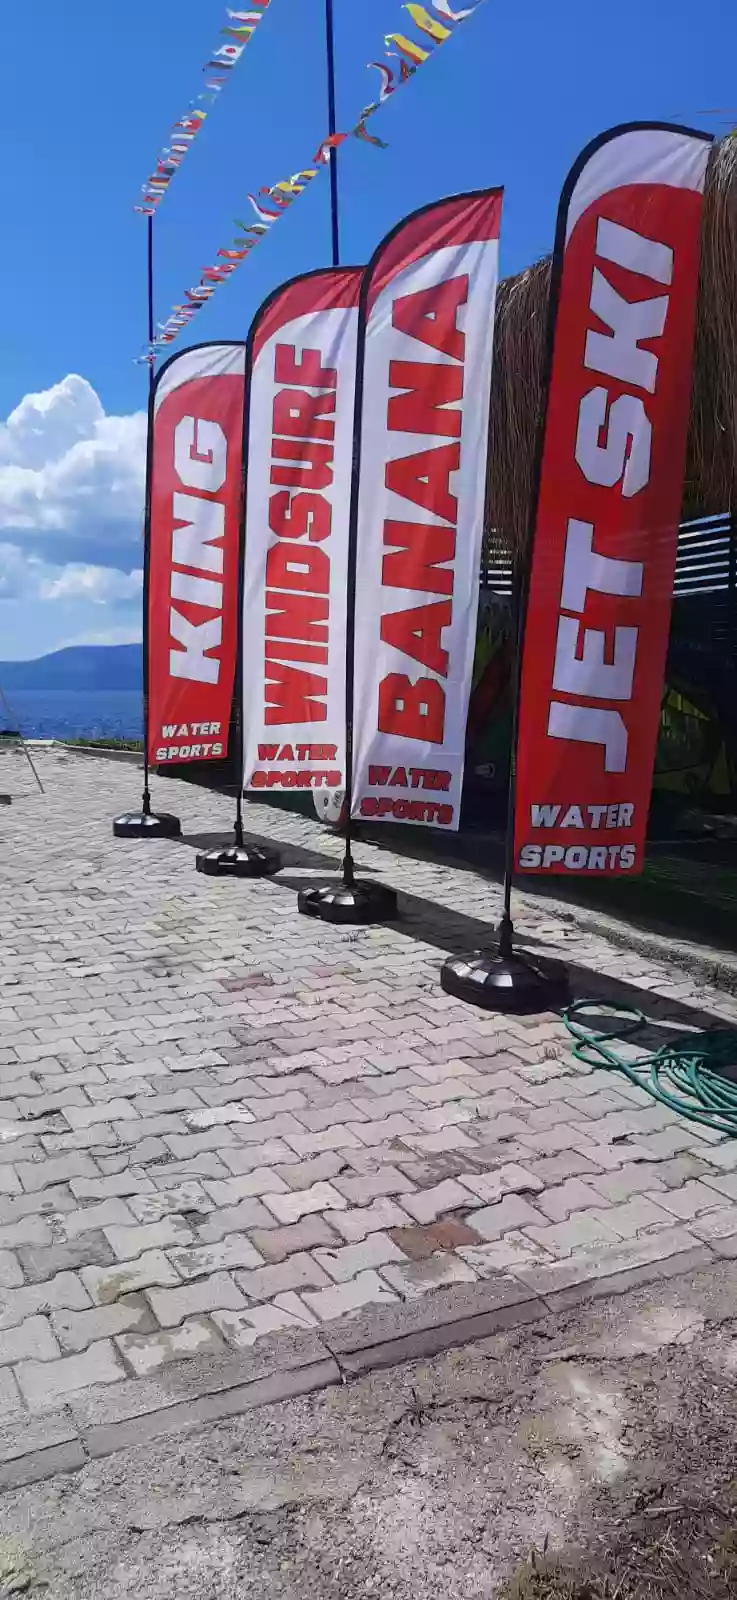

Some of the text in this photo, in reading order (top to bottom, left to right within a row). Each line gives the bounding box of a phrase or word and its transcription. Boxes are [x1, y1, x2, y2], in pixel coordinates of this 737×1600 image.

[546, 216, 674, 773] JET SKI
[378, 273, 469, 745] BANANA
[264, 343, 337, 726] WINDSURF
[169, 415, 228, 685] KING
[161, 721, 221, 738] WATER
[155, 742, 222, 761] SPORTS
[257, 743, 338, 761] WATER
[251, 770, 342, 788] SPORTS
[368, 765, 451, 791] WATER
[360, 797, 453, 824] SPORTS
[530, 803, 634, 829] WATER
[519, 843, 636, 871] SPORTS
